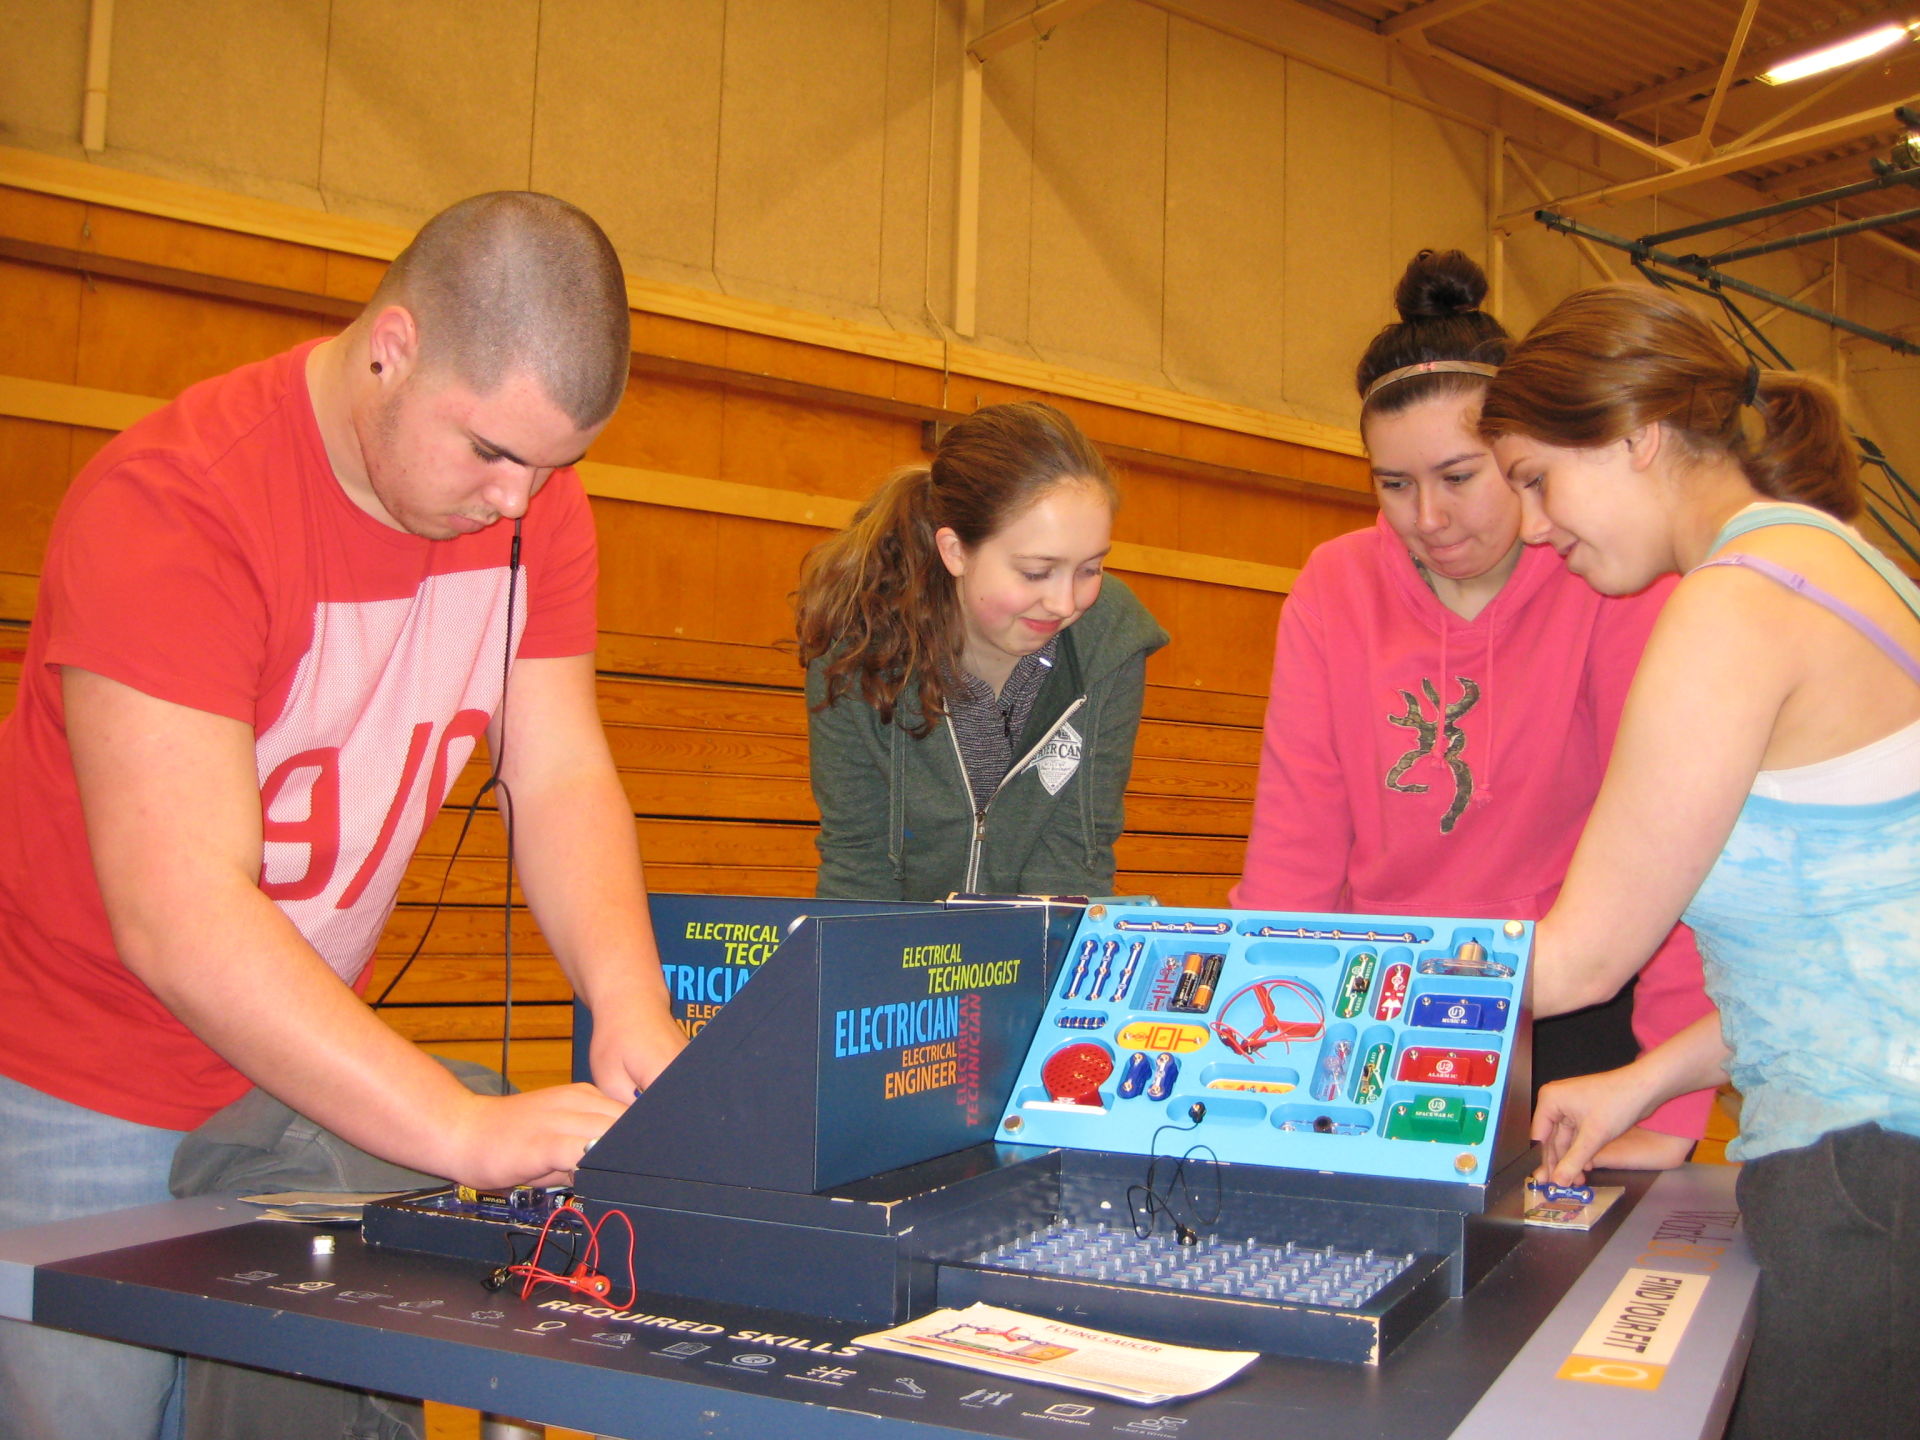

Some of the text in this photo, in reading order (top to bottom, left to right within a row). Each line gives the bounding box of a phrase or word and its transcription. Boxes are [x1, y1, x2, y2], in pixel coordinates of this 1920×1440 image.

[685, 922, 780, 943] ELECTRICAL
[902, 943, 962, 969] ELECTRICAL
[927, 960, 1021, 994] TECHNOLOGIST
[834, 995, 960, 1058] ELECTRICIAN
[902, 1041, 958, 1068] ELECTRICAL
[956, 994, 971, 1106] ELECTRICAL
[965, 993, 983, 1127] TECHNICIAN
[884, 1060, 959, 1100] ENGINEER
[537, 1299, 866, 1357] REQUIRED SKILLS
[1602, 1275, 1683, 1354] FIND YOUR FIT
[1045, 1324, 1163, 1354] FLYING SAUCER
[1049, 1414, 1091, 1427] Perception
